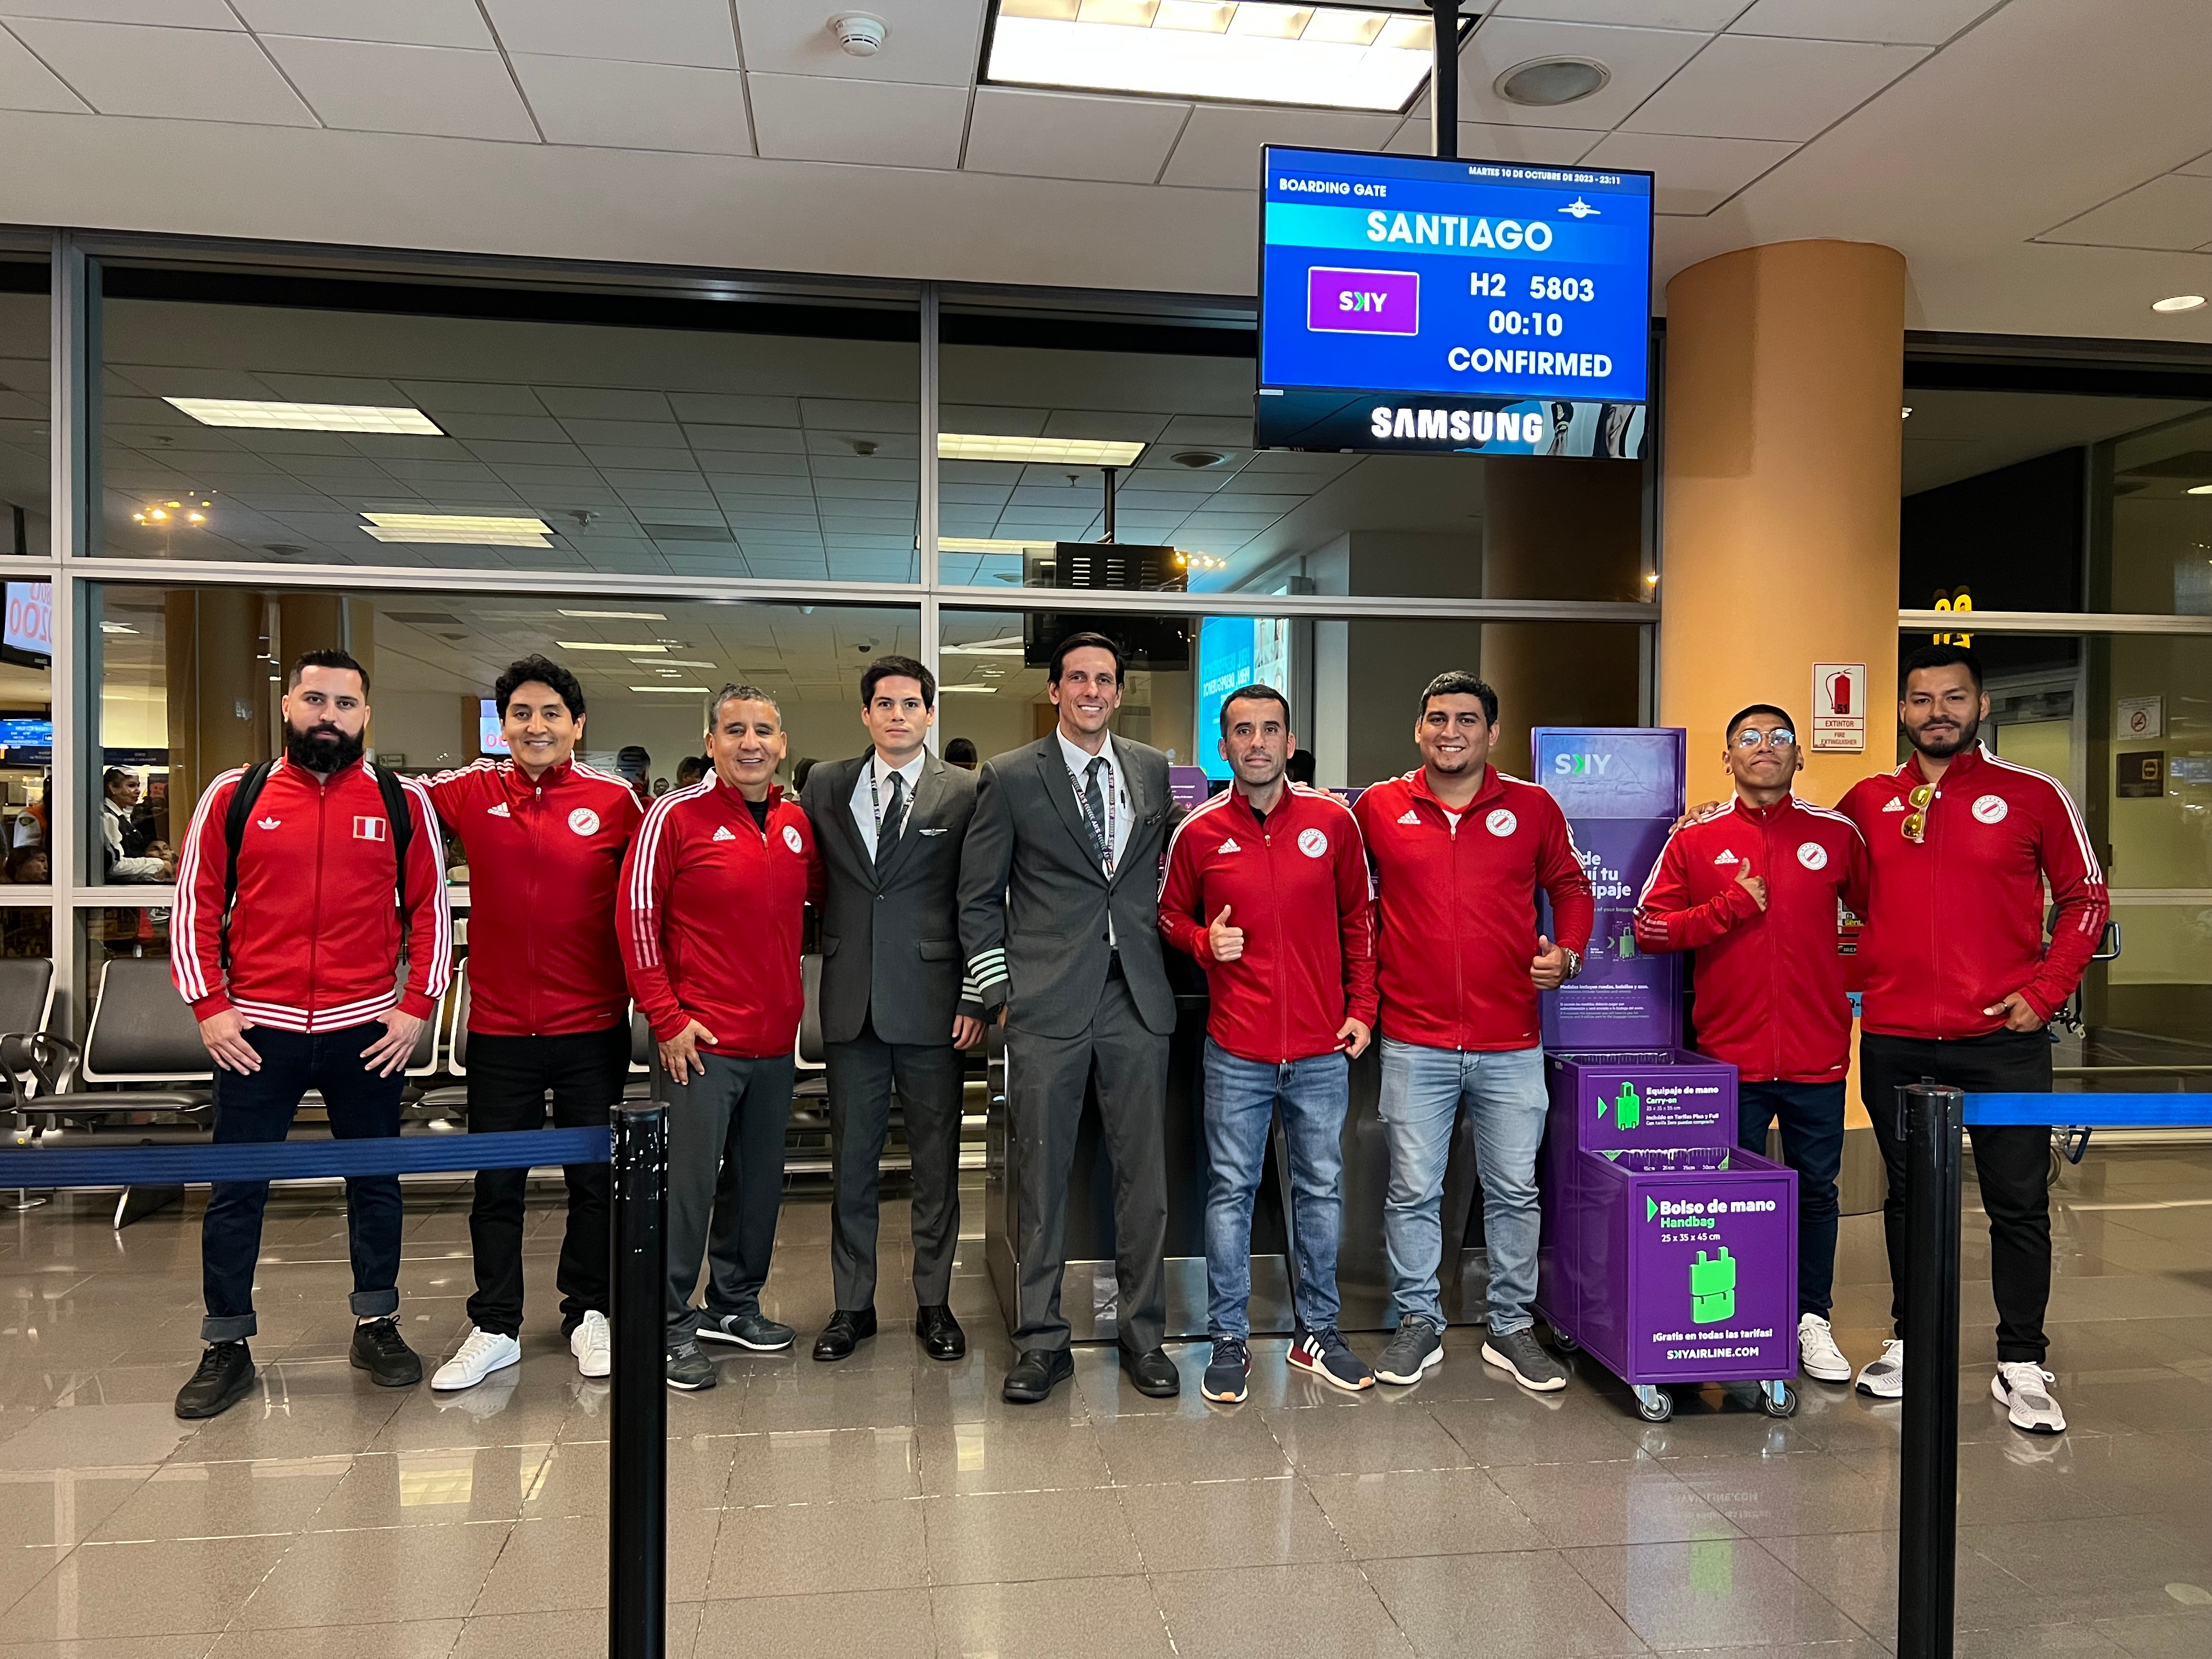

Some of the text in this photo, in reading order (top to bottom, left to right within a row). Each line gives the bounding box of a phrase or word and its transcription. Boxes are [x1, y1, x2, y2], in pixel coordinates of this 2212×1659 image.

[1469, 166, 1500, 177] MARTES
[1502, 168, 1511, 178] 10
[1513, 169, 1523, 178] DE
[1525, 170, 1561, 181] OCTUBRE
[1562, 172, 1572, 182] DE
[1574, 173, 1594, 183] 2023
[1599, 176, 1620, 184] 23:11
[1279, 178, 1386, 198] BOARDING GATE
[1367, 211, 1553, 251] SANTIAGO
[1470, 272, 1594, 302] H2 5803
[1339, 291, 1387, 313] SKY
[1489, 310, 1562, 336] 00:10
[1448, 347, 1612, 377] CONFIRMED
[1372, 406, 1543, 443] SAMSUNG
[1837, 704, 1848, 714] 51
[1555, 753, 1612, 774] SKY
[1582, 850, 1601, 865] de
[1600, 867, 1618, 881] tu
[1590, 882, 1631, 900] ipaje
[1646, 1086, 1682, 1096] Equipaje
[1683, 1086, 1694, 1094] de
[1660, 1198, 1776, 1215] Bolso de mano
[1661, 1216, 1715, 1229] Handbag
[1697, 1233, 1707, 1241] 45
[1653, 1331, 1683, 1342] ¡Gratis
[1699, 1330, 1724, 1340] todas
[1725, 1330, 1739, 1339] las
[1740, 1328, 1773, 1339] tarifas!
[1667, 1347, 1759, 1359] SKYAIRLINE.COM
